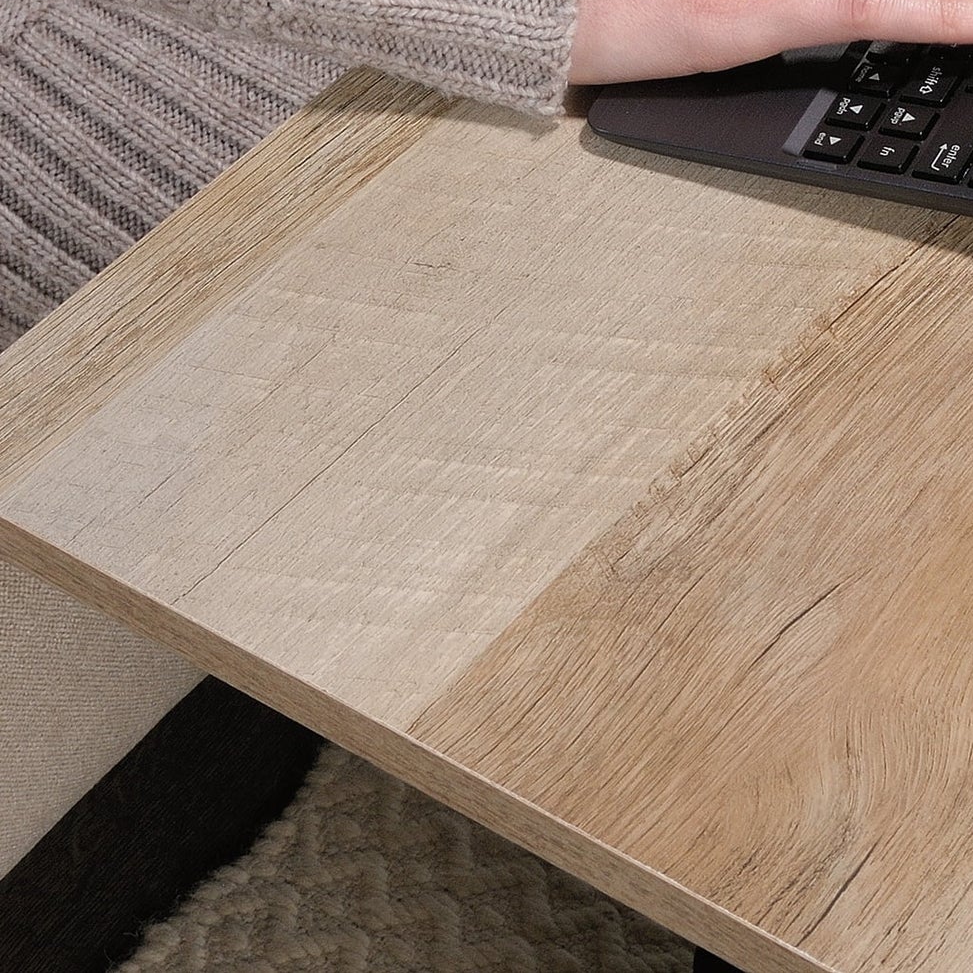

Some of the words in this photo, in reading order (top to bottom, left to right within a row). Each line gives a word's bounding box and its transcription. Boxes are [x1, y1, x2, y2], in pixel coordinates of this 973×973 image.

[854, 65, 873, 83] home
[924, 66, 942, 86] shift
[836, 97, 851, 115] pgdn
[890, 107, 906, 125] pgup
[814, 132, 827, 146] end
[879, 146, 895, 156] fn
[941, 144, 961, 168] enter
